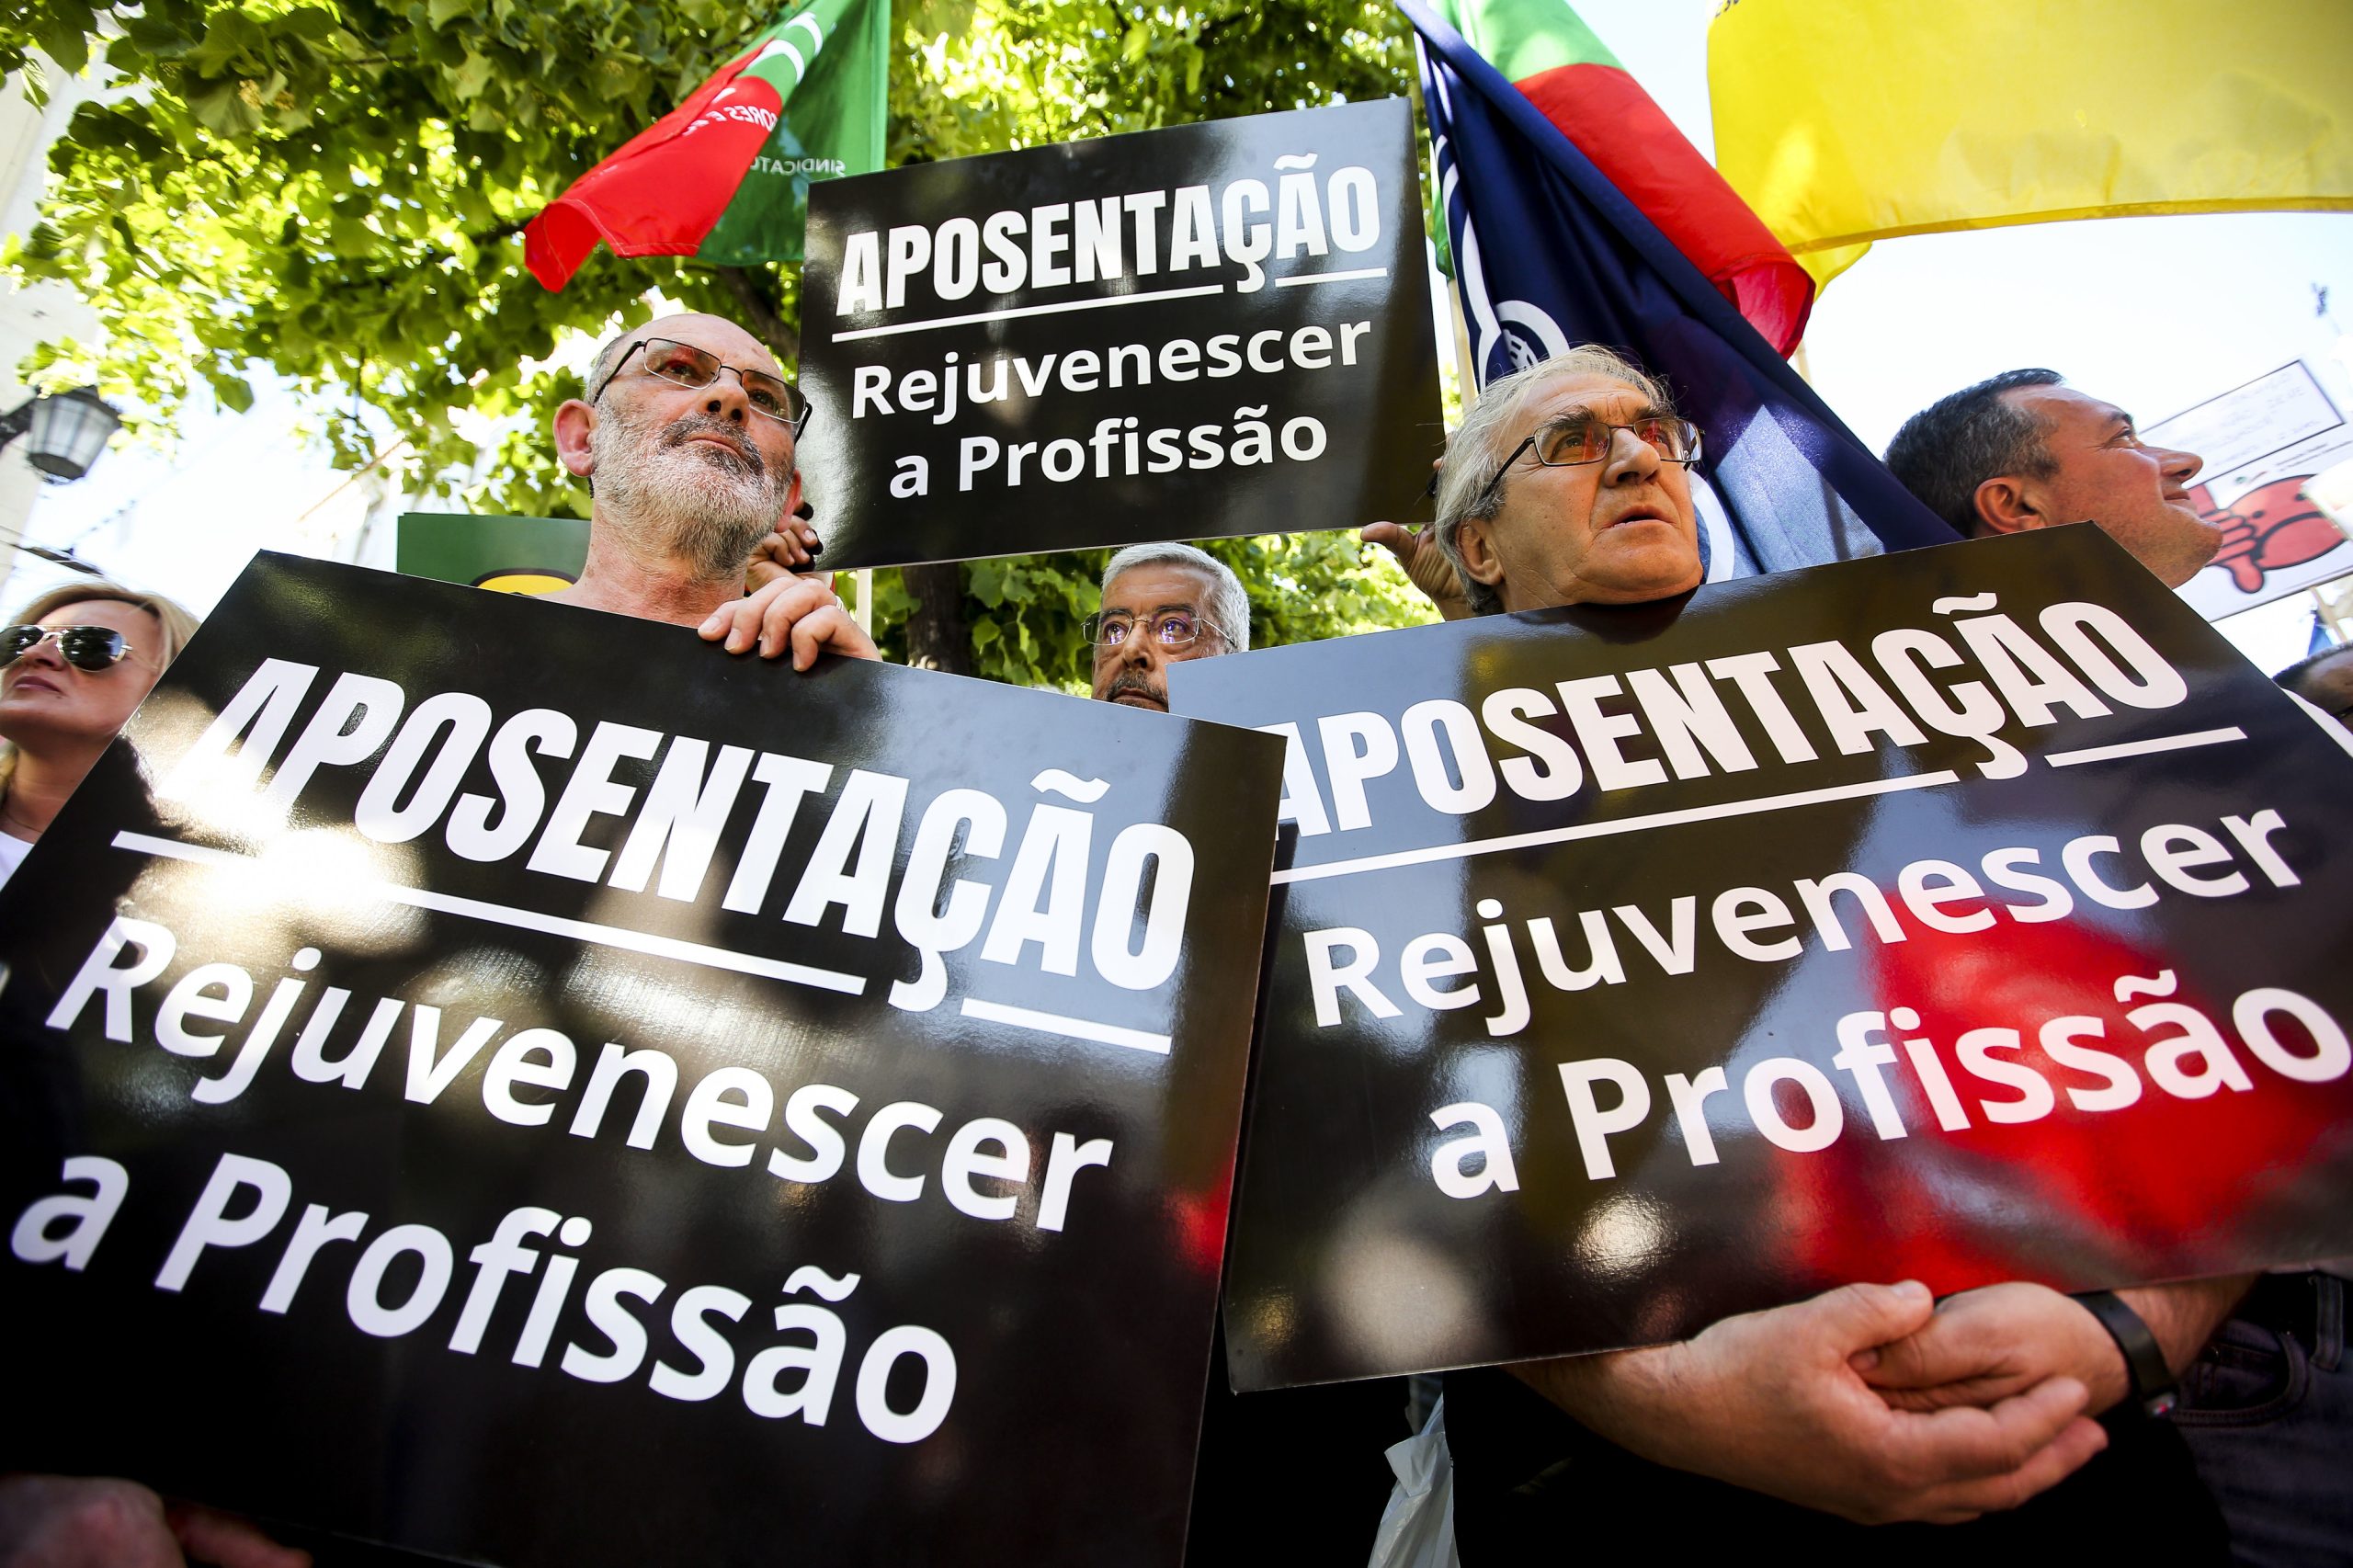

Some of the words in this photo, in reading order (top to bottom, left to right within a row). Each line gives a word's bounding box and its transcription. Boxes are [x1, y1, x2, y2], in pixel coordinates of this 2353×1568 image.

[836, 153, 1380, 317] APOSENTAÇÃO
[852, 320, 1372, 427] Rejuvenescer
[890, 455, 929, 499] a
[959, 405, 1328, 492] Profissão
[1250, 592, 2188, 840] APOSENTAÇÃO
[153, 657, 1195, 1014] APOSENTAÇÃO
[1302, 809, 2301, 1038] Rejuvenescer
[45, 915, 1114, 1233] Rejuvenescer
[1429, 1101, 1520, 1199] a
[1558, 970, 2353, 1184] Profissão
[10, 1155, 129, 1273] a
[154, 1153, 958, 1444] Profissão
